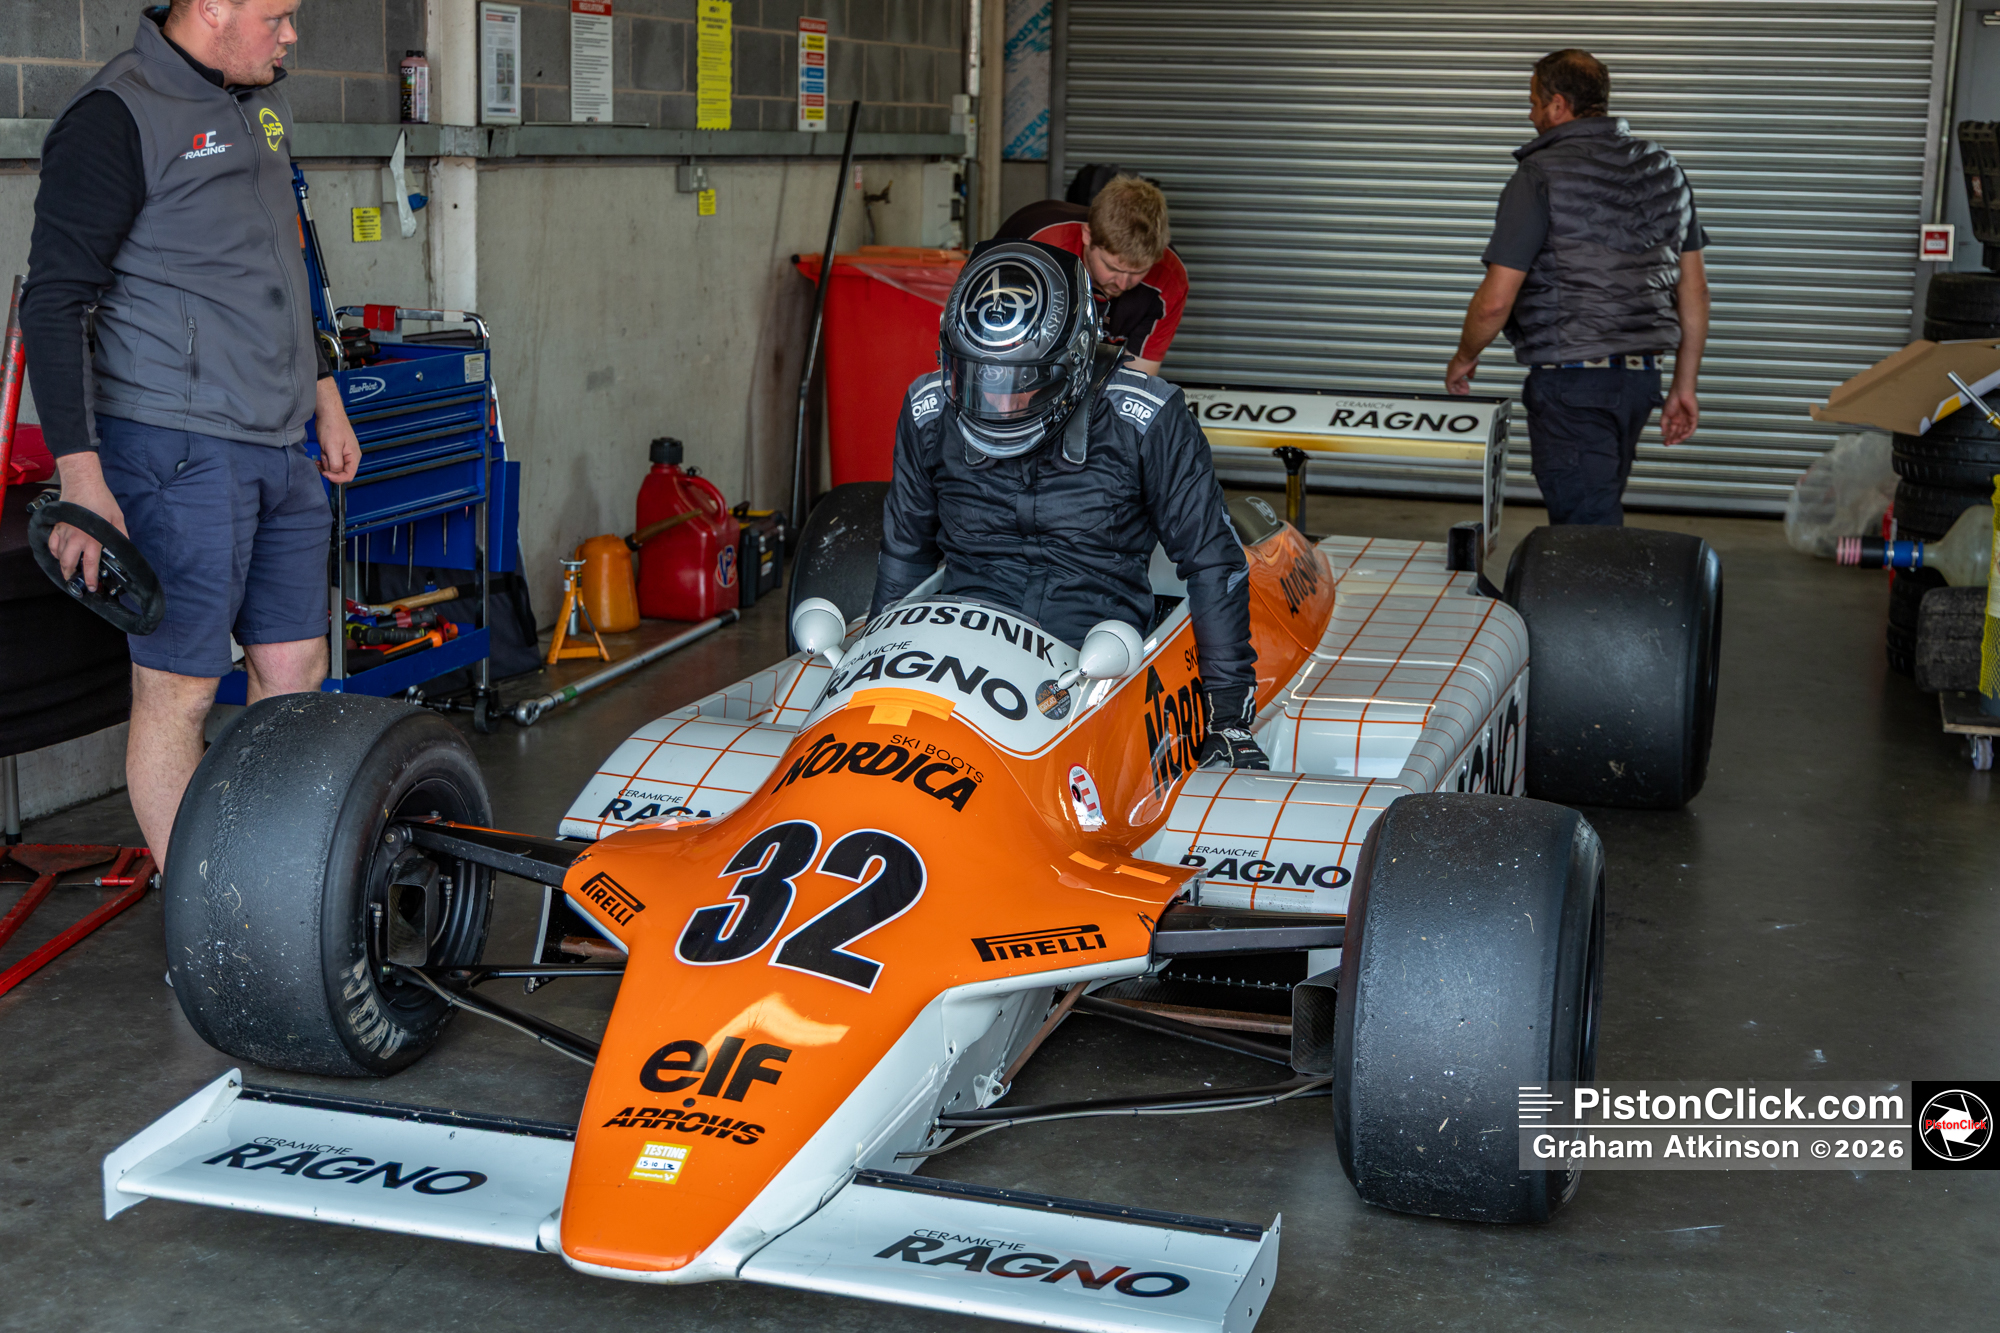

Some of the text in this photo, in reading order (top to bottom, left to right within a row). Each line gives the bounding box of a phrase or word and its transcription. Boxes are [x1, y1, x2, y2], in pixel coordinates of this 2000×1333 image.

[263, 122, 284, 136] DSR
[185, 145, 226, 159] RACING
[1044, 290, 1065, 342] ASPRIA
[912, 396, 938, 417] OMP
[1121, 402, 1152, 420] OMP
[1188, 401, 1297, 423] AGNO
[1328, 408, 1479, 433] RAGNO
[1336, 400, 1395, 410] CERAMICHE
[827, 650, 1029, 721] RAGNO
[1144, 664, 1208, 800] NORD
[772, 733, 979, 813] NORDICA
[890, 734, 984, 783] SKI BOOTS
[618, 788, 683, 804] CERAMICHE
[1188, 844, 1259, 858] CERAMICHE
[580, 871, 646, 927] PIRELLI
[673, 819, 928, 994] 32
[971, 924, 1107, 962] PIRELLI
[639, 1035, 793, 1103] elf
[602, 1107, 766, 1145] ARROWS
[253, 1136, 353, 1155] CERAMICHE
[643, 1144, 688, 1159] TESTING
[201, 1142, 488, 1195] RAGNO
[913, 1228, 1026, 1251] CERAMICHE
[873, 1235, 1190, 1298] RAGNO
